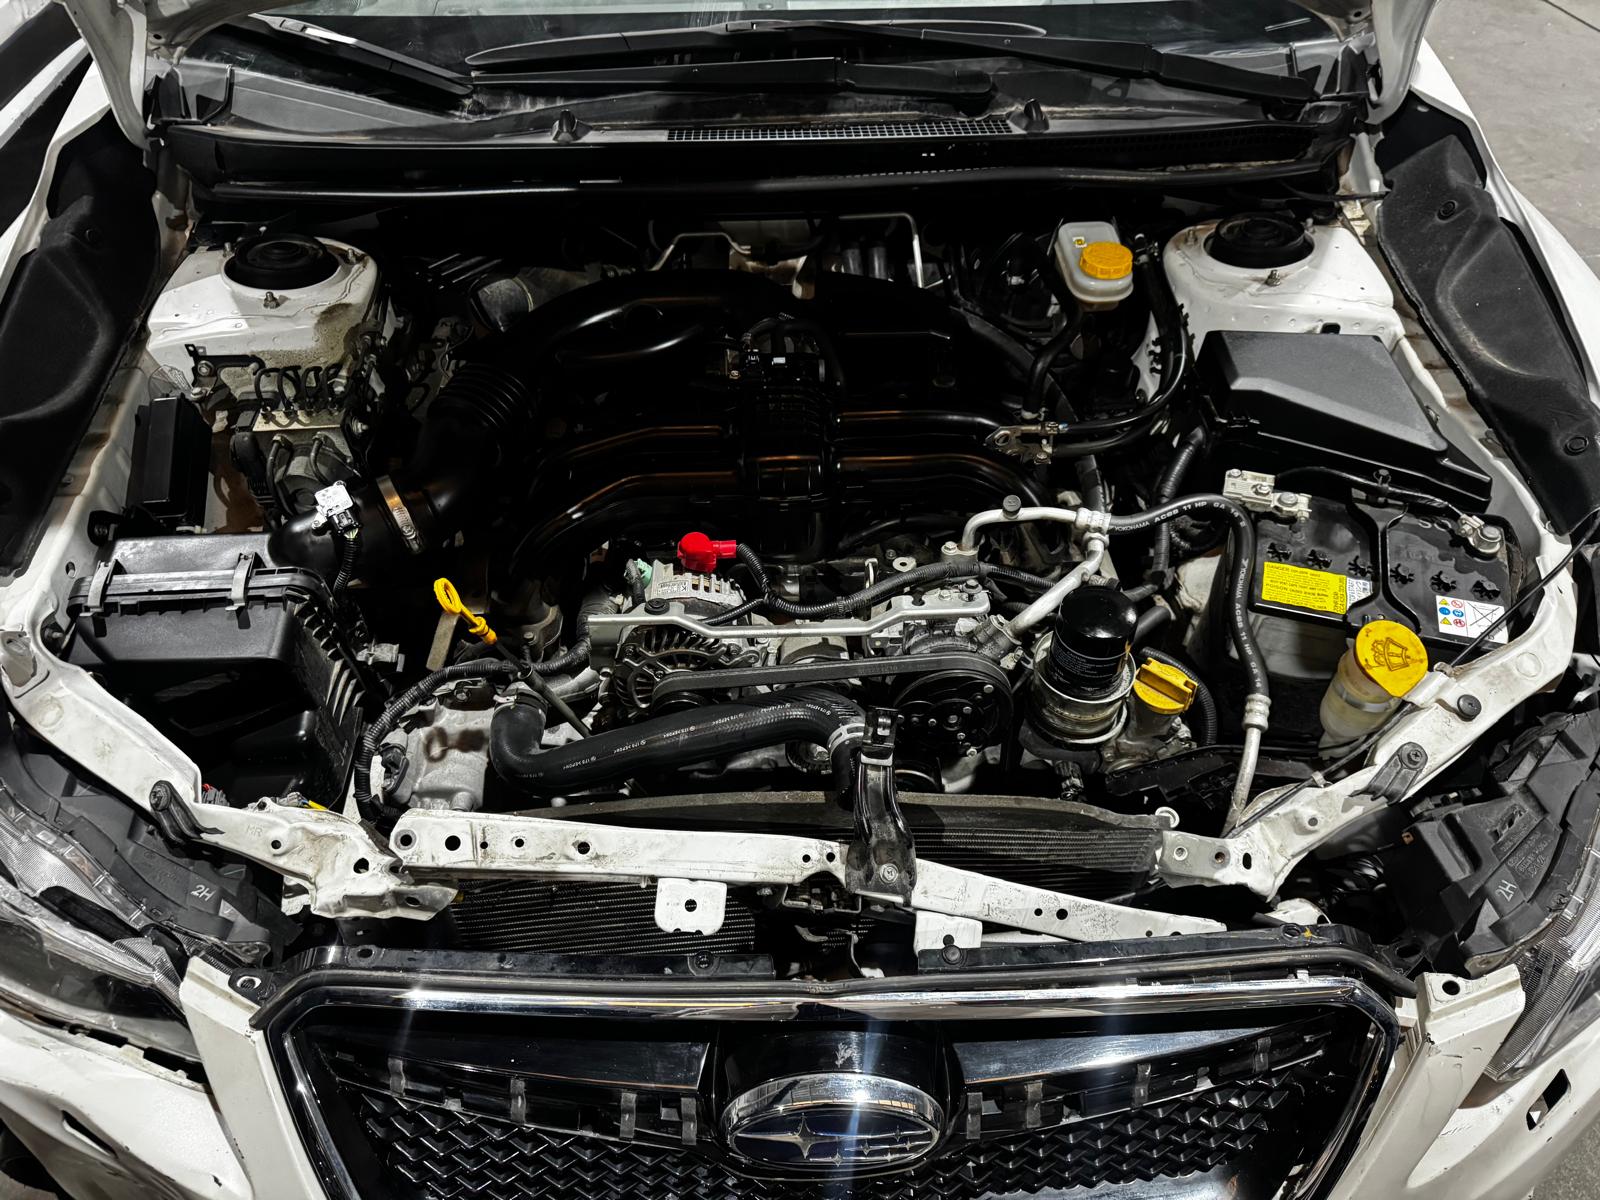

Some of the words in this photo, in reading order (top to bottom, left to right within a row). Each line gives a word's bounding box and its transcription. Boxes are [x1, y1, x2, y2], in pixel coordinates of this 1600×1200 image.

[1114, 520, 1150, 532] YOKOHAMA
[1244, 643, 1253, 655] HP
[190, 884, 217, 902] 2H
[1495, 879, 1518, 902] 2H
